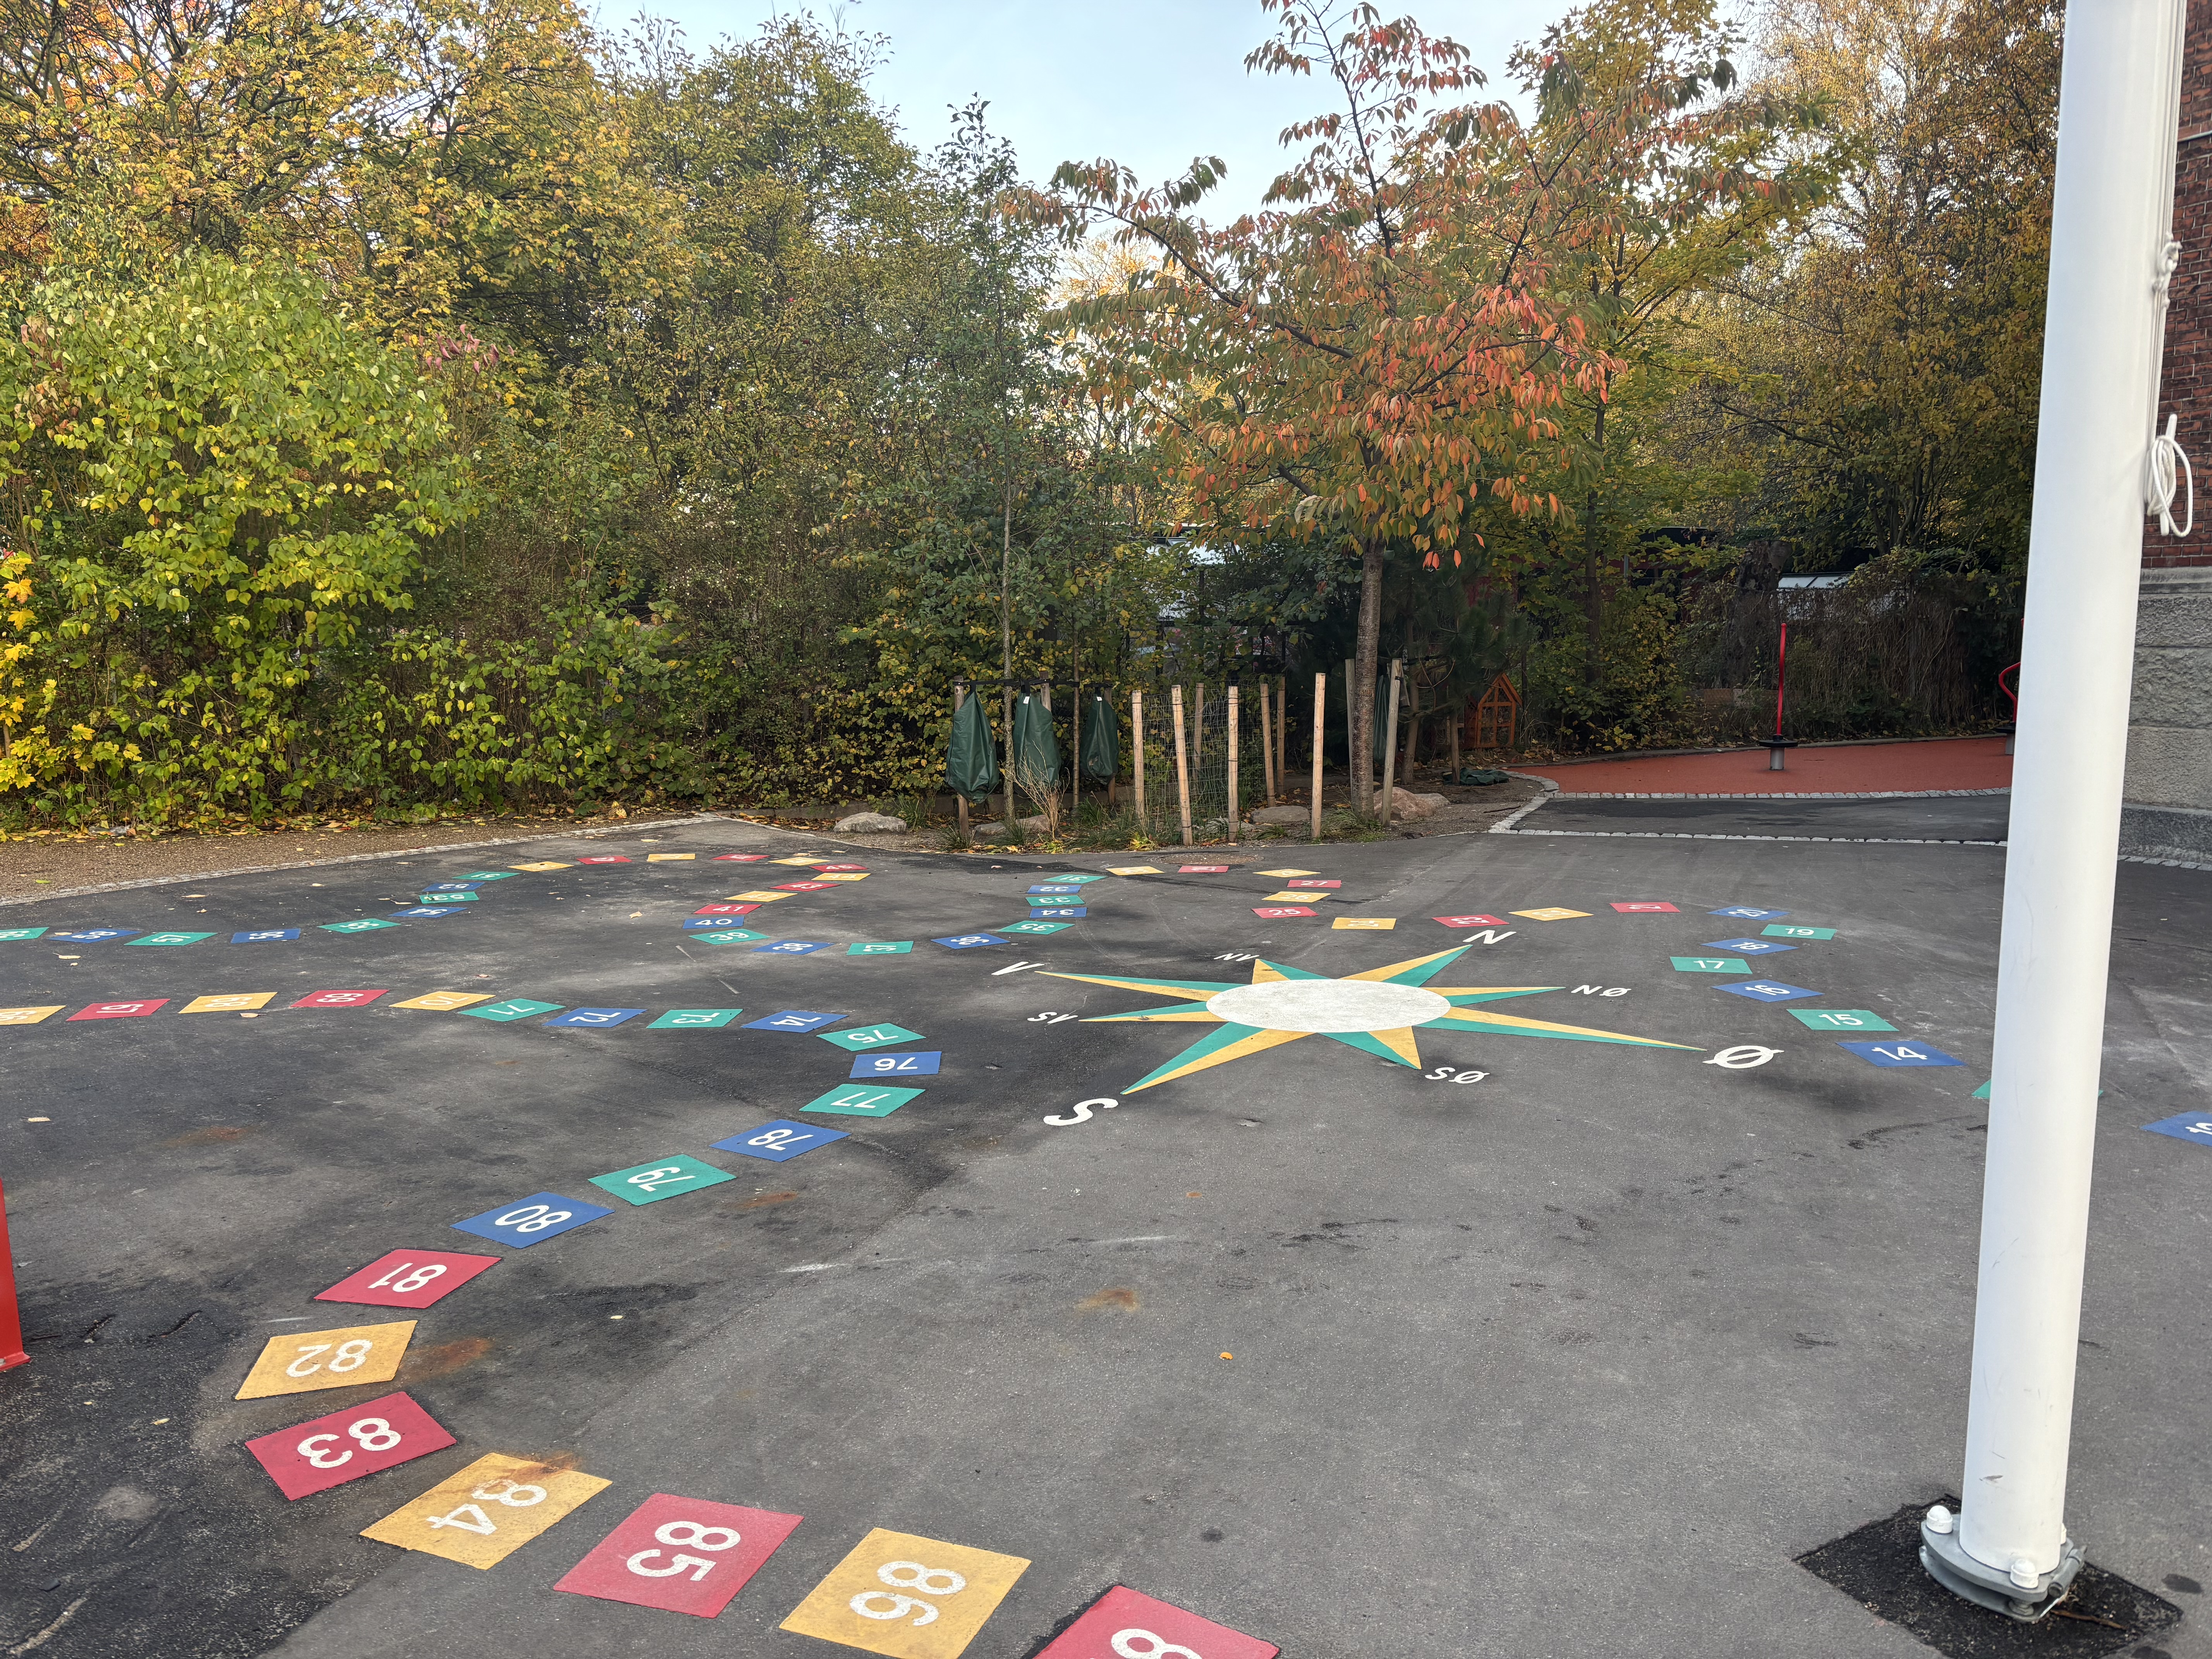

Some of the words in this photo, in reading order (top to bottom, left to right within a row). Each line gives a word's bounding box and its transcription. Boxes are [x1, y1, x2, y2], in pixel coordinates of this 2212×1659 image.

[1463, 930, 1516, 944] N
[991, 962, 1044, 975] V
[1571, 985, 1632, 996] NØ
[1745, 985, 1790, 995] 16
[205, 997, 253, 1007] 68
[316, 993, 364, 1002] 69
[419, 996, 470, 1005] 70
[96, 1004, 144, 1013] 67
[488, 1005, 535, 1015] 71
[568, 1013, 621, 1022] 72
[672, 1013, 720, 1023] 73
[770, 1016, 821, 1026] 74
[1027, 1012, 1078, 1024] SV
[1819, 1014, 1863, 1025] 15
[848, 1030, 898, 1043] 75
[1702, 1046, 1784, 1068] Ø
[1872, 1047, 1927, 1060] 14
[875, 1058, 917, 1070] 76
[1425, 1067, 1490, 1084] SØ
[831, 1092, 891, 1108] 77
[1043, 1098, 1118, 1126] S
[748, 1129, 813, 1150] 78
[627, 1167, 696, 1192] 79
[495, 1205, 572, 1232] 80
[368, 1263, 447, 1292] 81
[286, 1340, 373, 1377] 82
[297, 1418, 401, 1468] 83
[426, 1480, 547, 1535] 84
[627, 1521, 740, 1581] 85
[849, 1561, 966, 1626] 86
[1111, 1629, 1202, 1659] 8
